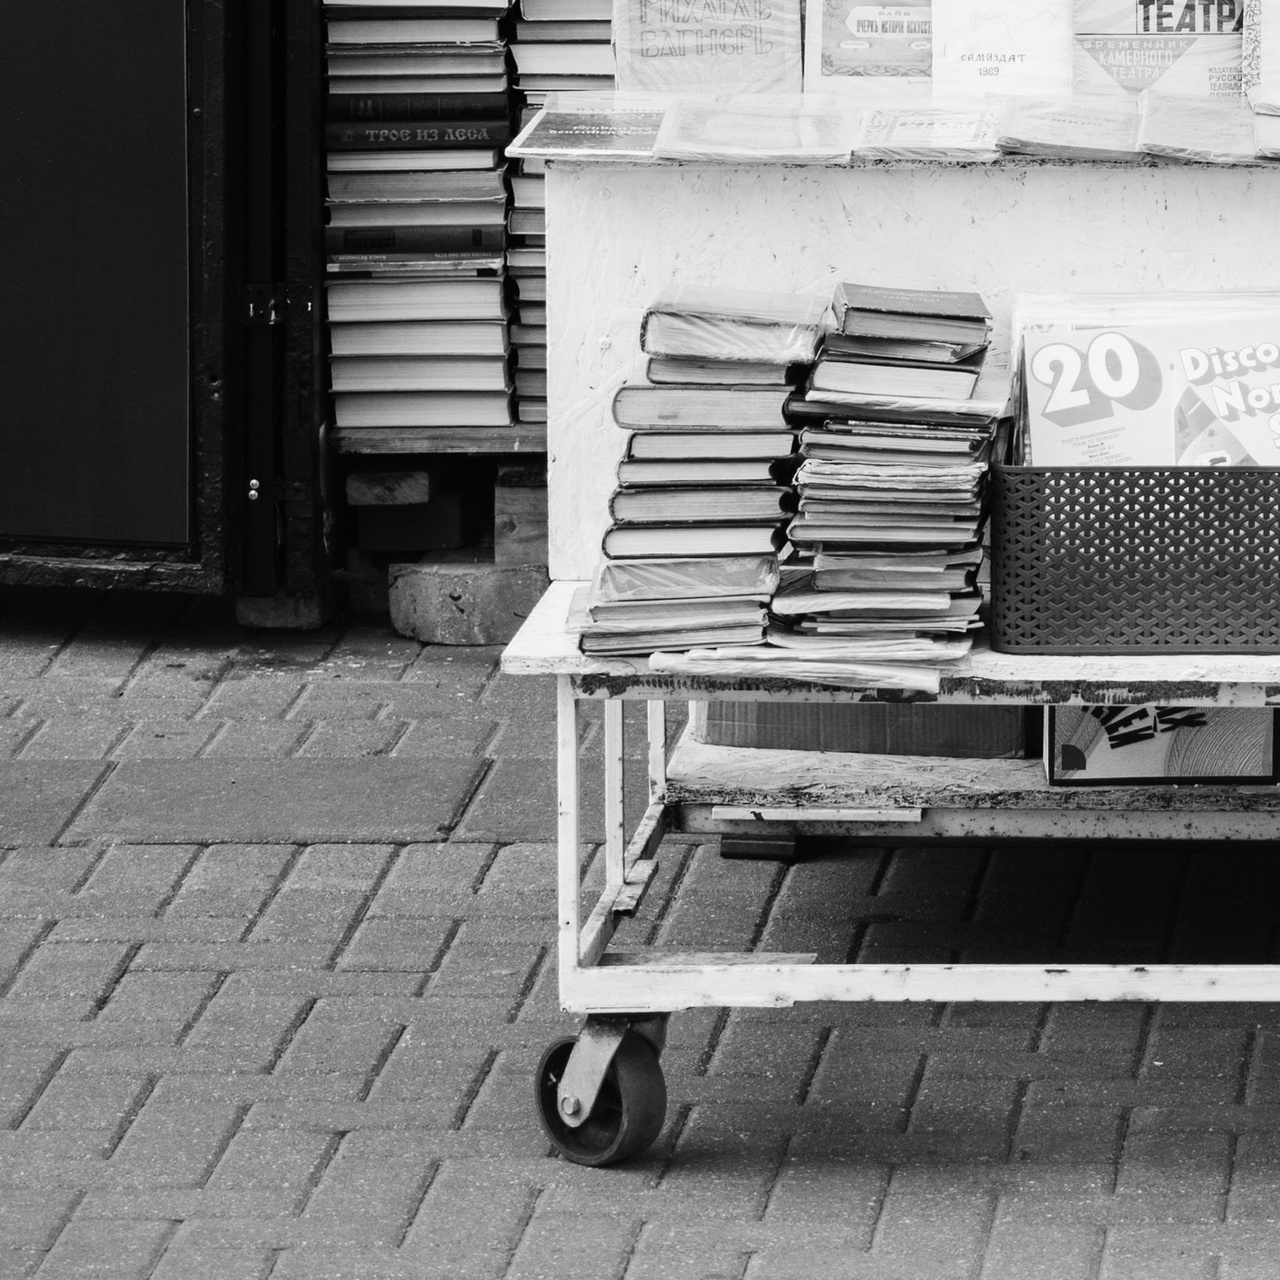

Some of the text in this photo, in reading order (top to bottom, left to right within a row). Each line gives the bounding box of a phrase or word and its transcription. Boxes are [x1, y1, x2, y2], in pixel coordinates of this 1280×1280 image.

[1083, 40, 1188, 49] ВРЕМЕННИК
[960, 52, 1026, 63] САМИЗДАТ
[1099, 50, 1173, 65] КАМЕРНОГО
[978, 66, 1000, 76] 1989
[1112, 67, 1161, 79] ТЕАТРА
[365, 128, 490, 141] ТРОЕ ИЗ ЛЕСА
[1030, 331, 1152, 421] 20
